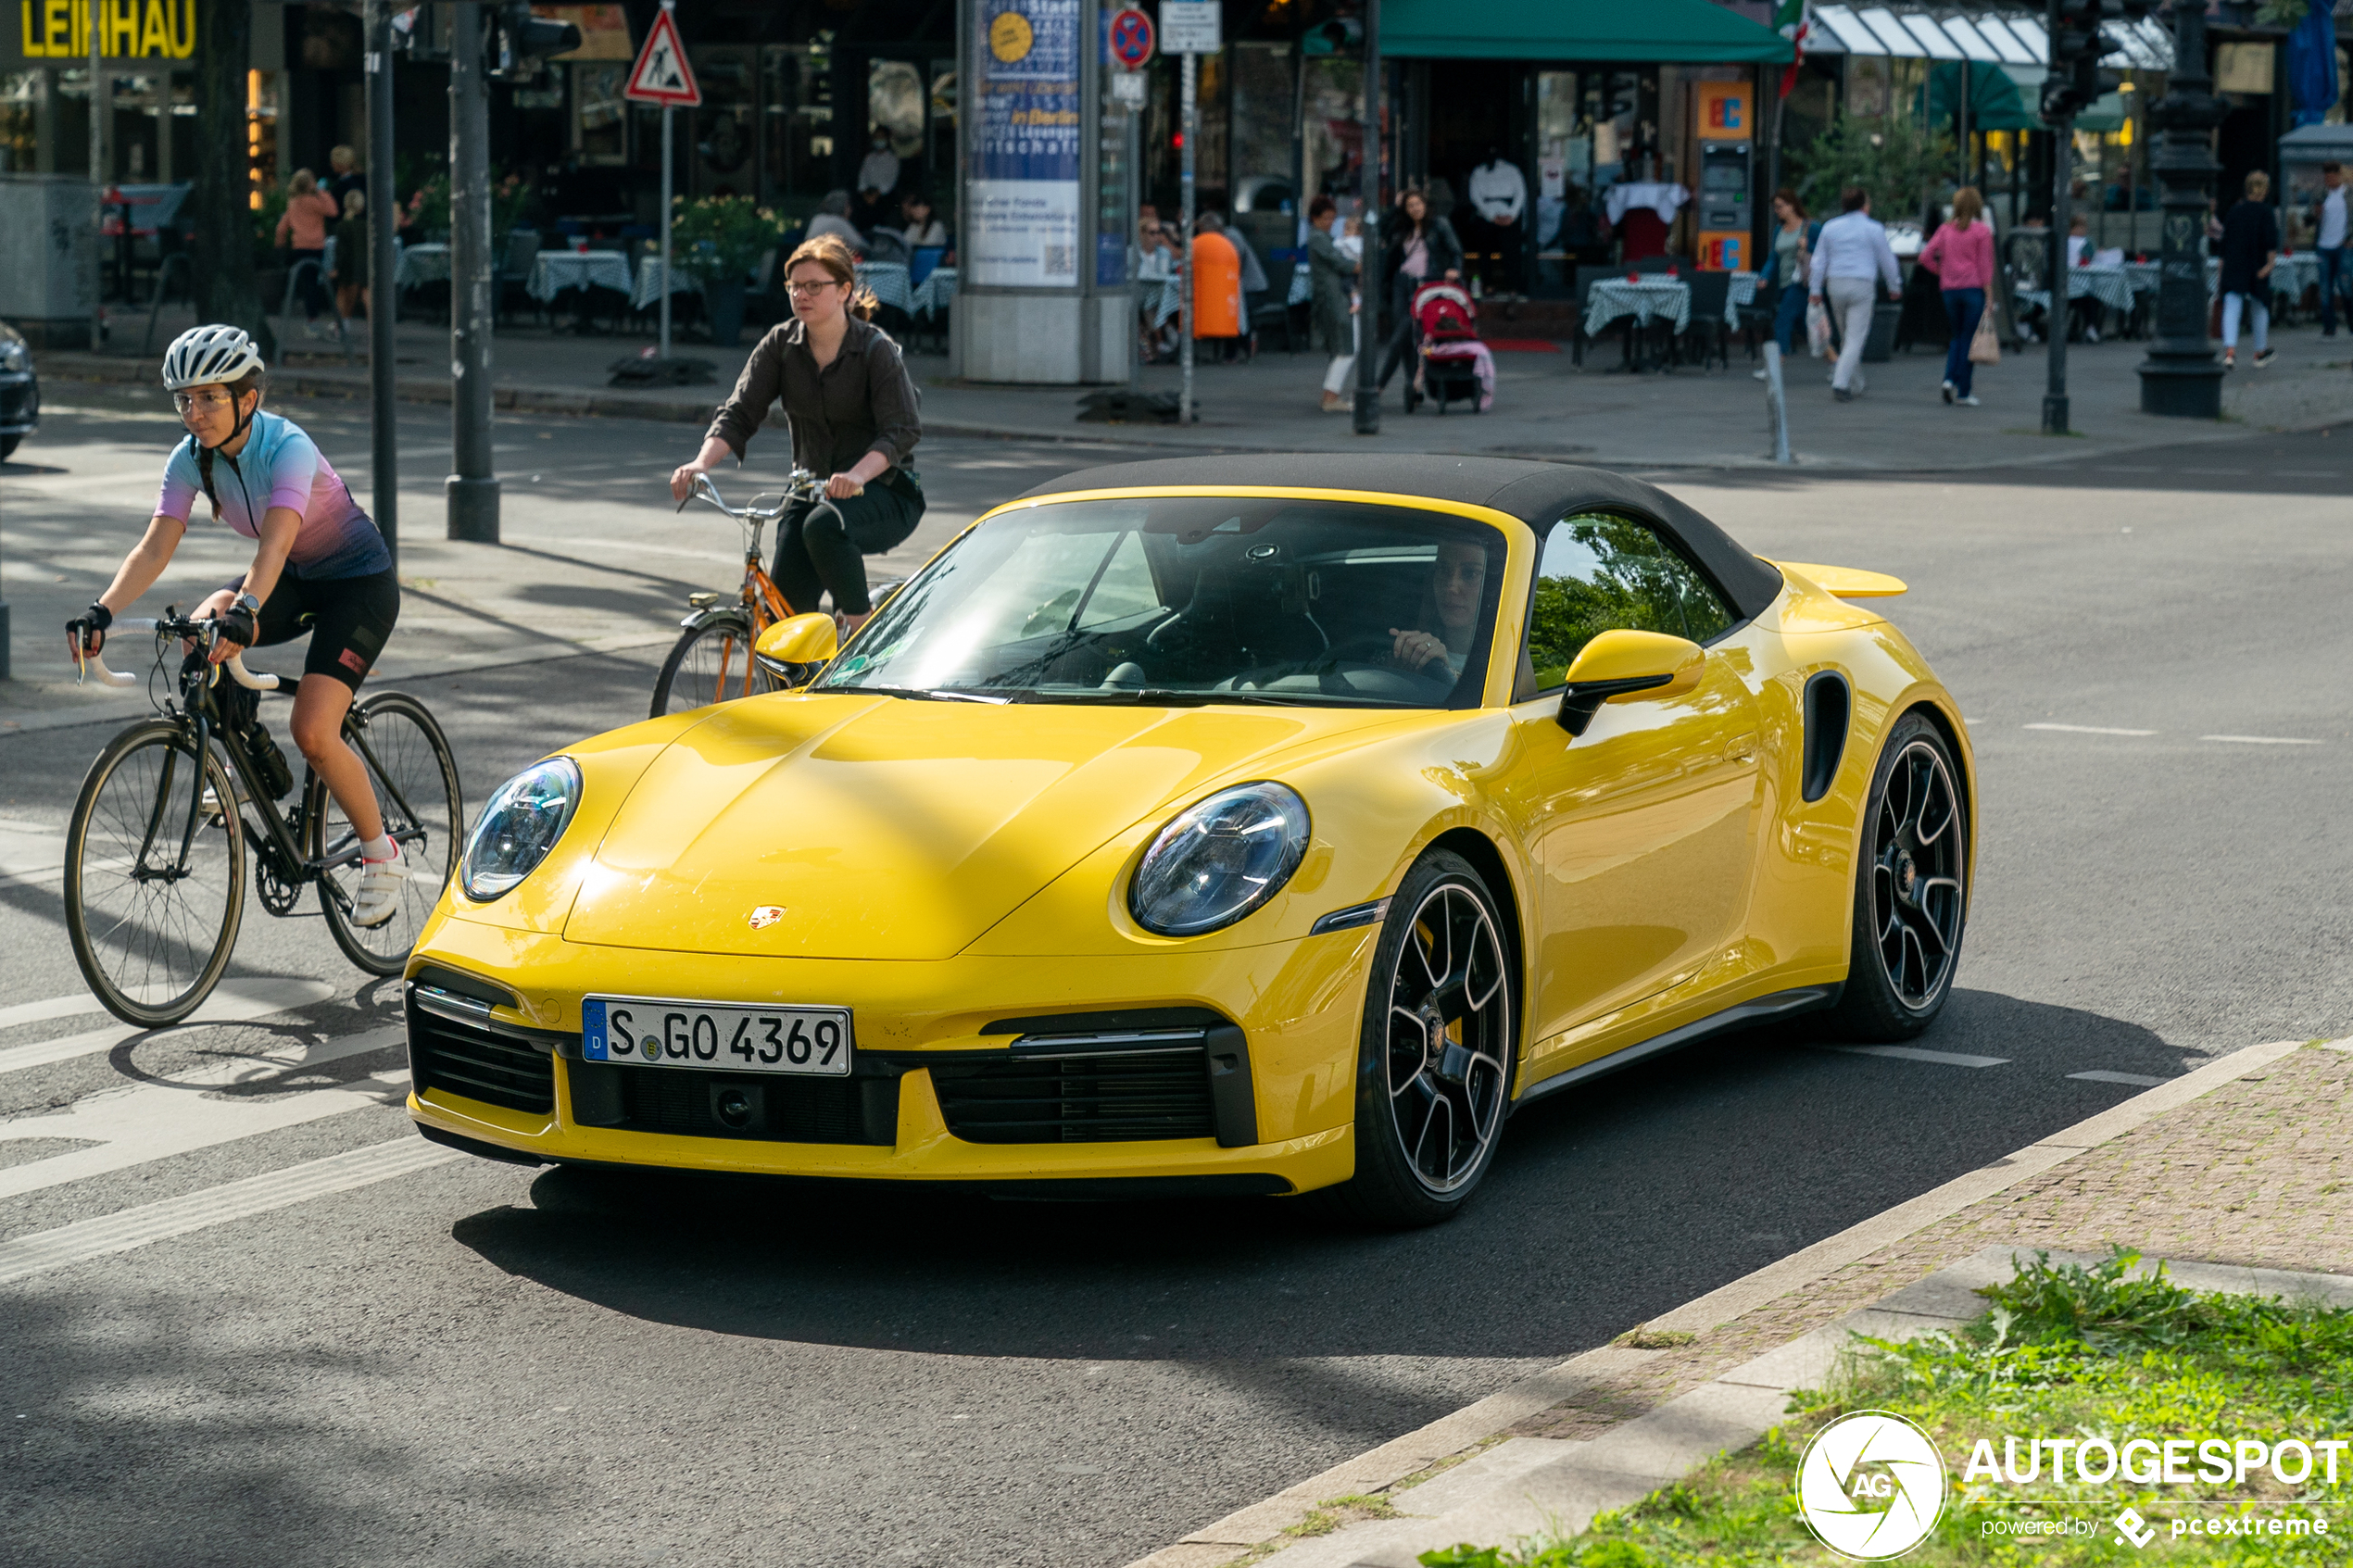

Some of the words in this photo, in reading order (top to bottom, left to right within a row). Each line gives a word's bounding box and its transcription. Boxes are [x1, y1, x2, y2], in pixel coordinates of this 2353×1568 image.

[1708, 97, 1742, 130] EC
[1708, 238, 1740, 270] EC
[592, 1036, 601, 1049] D
[610, 1010, 635, 1056] S
[664, 1012, 719, 1060] GO
[730, 1016, 841, 1066] 4369
